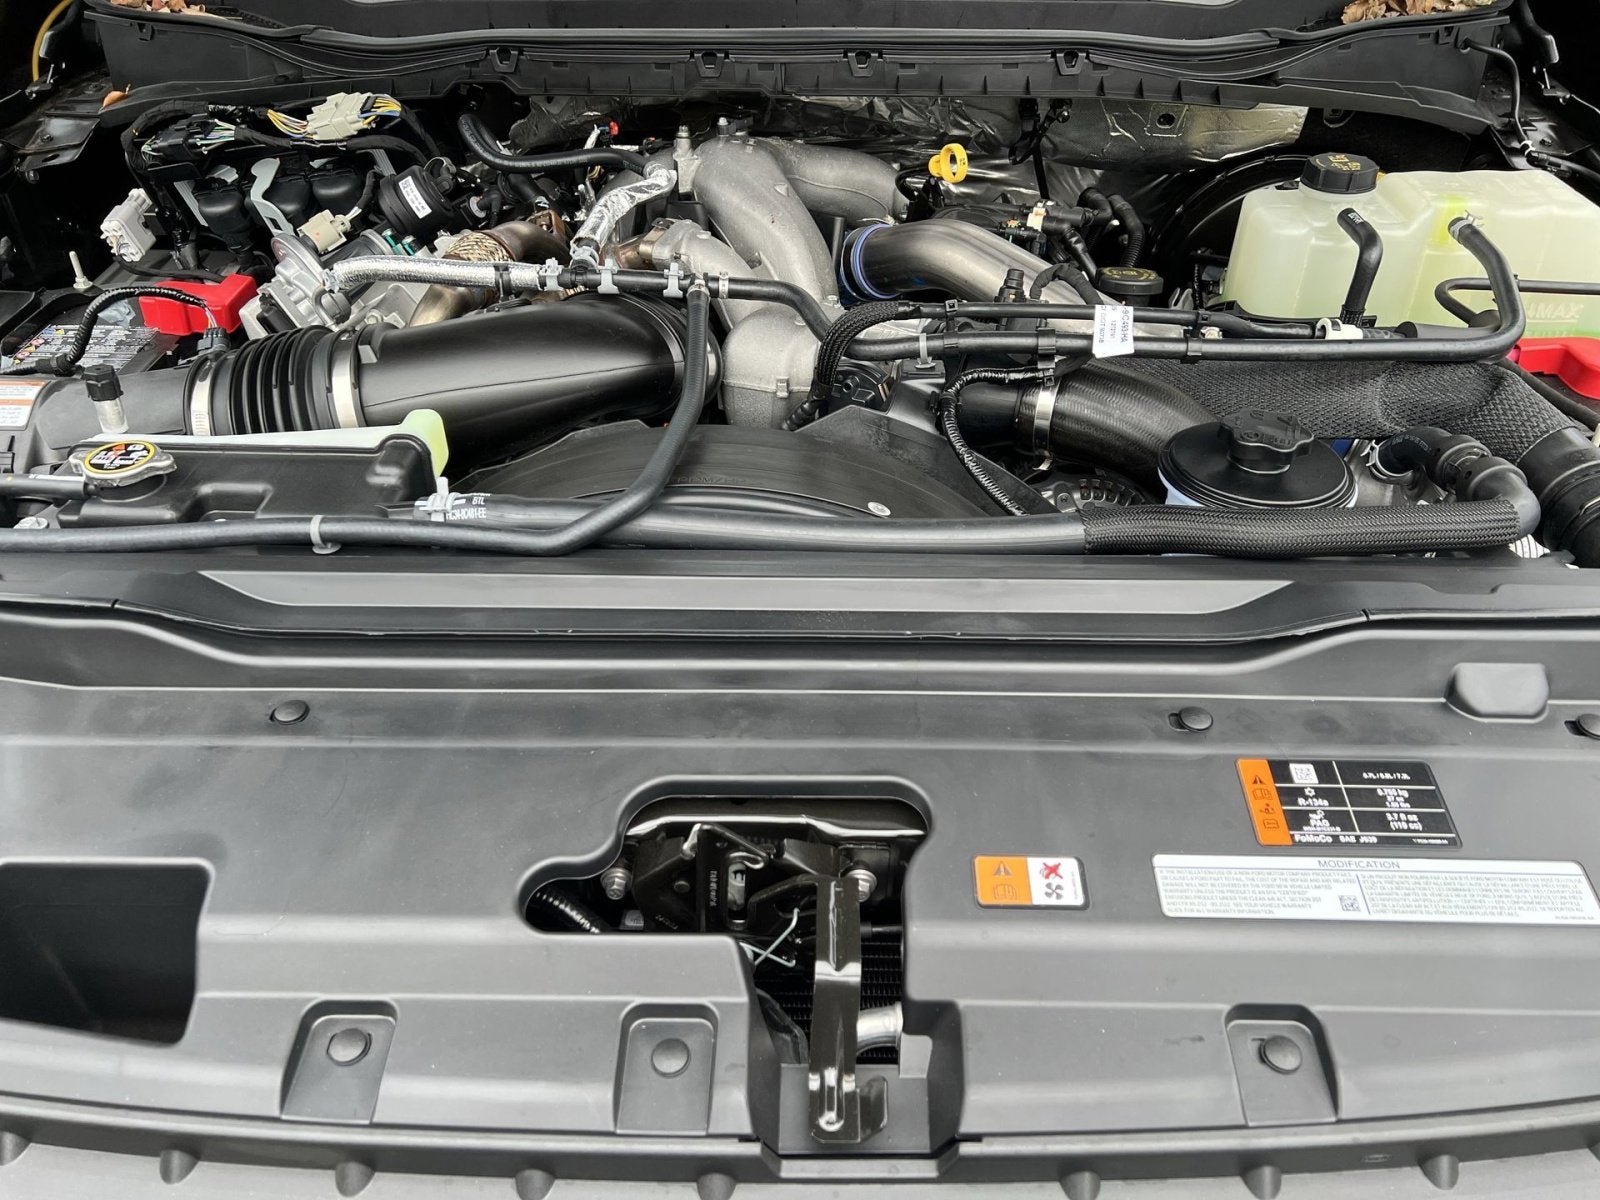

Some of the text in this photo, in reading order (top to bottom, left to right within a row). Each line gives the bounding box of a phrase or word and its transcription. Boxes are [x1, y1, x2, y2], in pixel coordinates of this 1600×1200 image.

[471, 496, 486, 505] BTL
[1297, 797, 1329, 806] R-134a
[1294, 834, 1333, 843] FoMoCo
[1317, 859, 1401, 869] MODIFICATION
